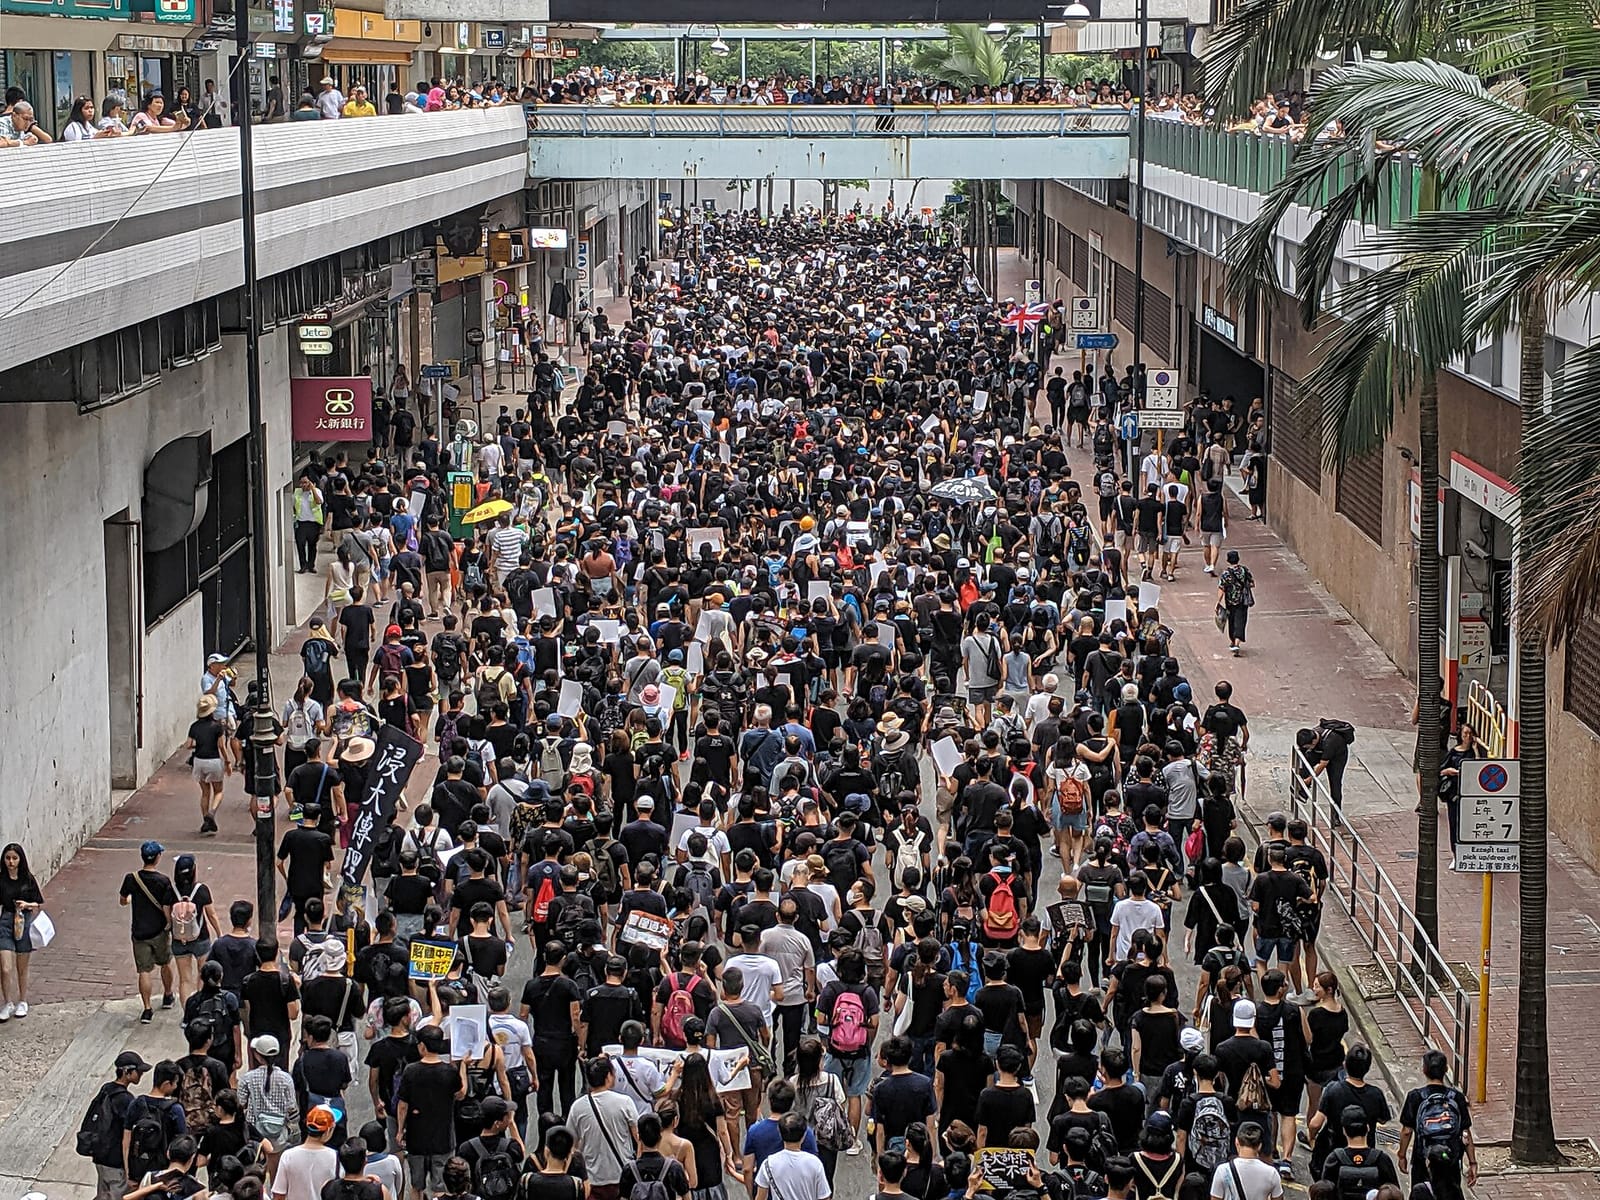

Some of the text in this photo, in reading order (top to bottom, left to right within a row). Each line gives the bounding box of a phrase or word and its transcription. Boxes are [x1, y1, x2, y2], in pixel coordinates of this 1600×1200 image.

[315, 418, 366, 430] 大新銀行
[1472, 800, 1513, 815] 上午 7
[1472, 824, 1513, 839] 下午 7
[1471, 846, 1495, 854] Except
[1462, 853, 1517, 862] pick up/drop off
